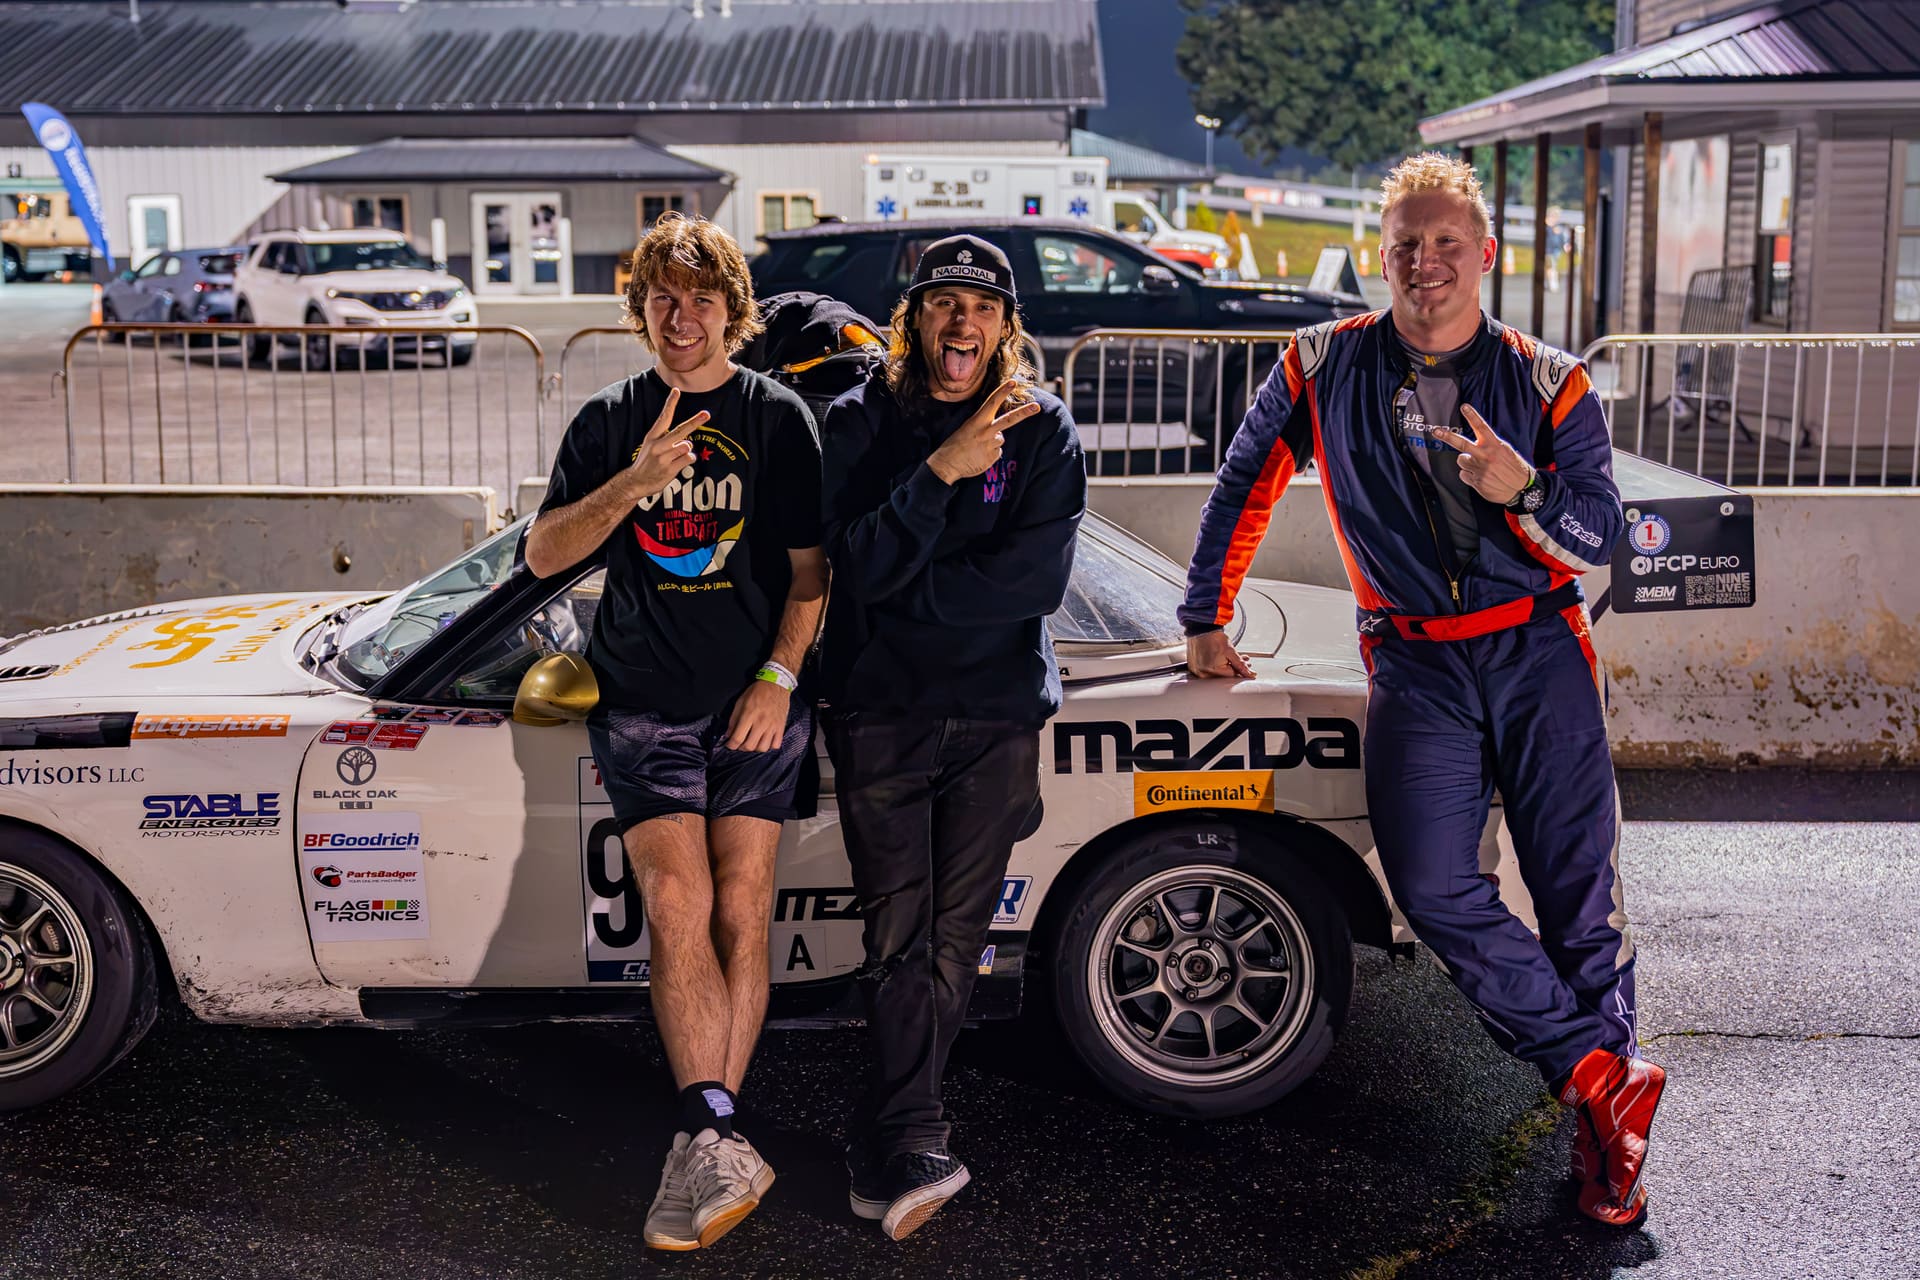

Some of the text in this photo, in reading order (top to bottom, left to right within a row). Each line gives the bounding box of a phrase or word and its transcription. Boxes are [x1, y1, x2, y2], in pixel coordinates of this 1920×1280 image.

[935, 267, 993, 280] NACIONAL
[702, 434, 717, 445] THE
[715, 441, 736, 461] WORLD
[656, 521, 682, 541] THE
[1654, 555, 1740, 573] FCP EURO
[1716, 573, 1750, 584] NINE
[1643, 585, 1677, 598] MBM
[1716, 583, 1750, 593] LIVES
[1716, 597, 1750, 605] RACING
[138, 716, 286, 737] blipshift
[0, 758, 145, 785] dvisors LLC
[313, 790, 398, 799] BLACK OAK
[1146, 784, 1245, 806] Continental
[142, 793, 280, 819] STABLE
[142, 818, 277, 829] ENERGIES
[142, 829, 280, 838] MOTORSPORTS
[303, 832, 419, 847] BFGoodrich
[1197, 833, 1219, 846] LR
[346, 871, 418, 879] PartsBadger
[586, 817, 643, 948] 9
[314, 900, 370, 911] FLAG
[325, 910, 420, 922] TRONICS
[787, 934, 815, 971] A
